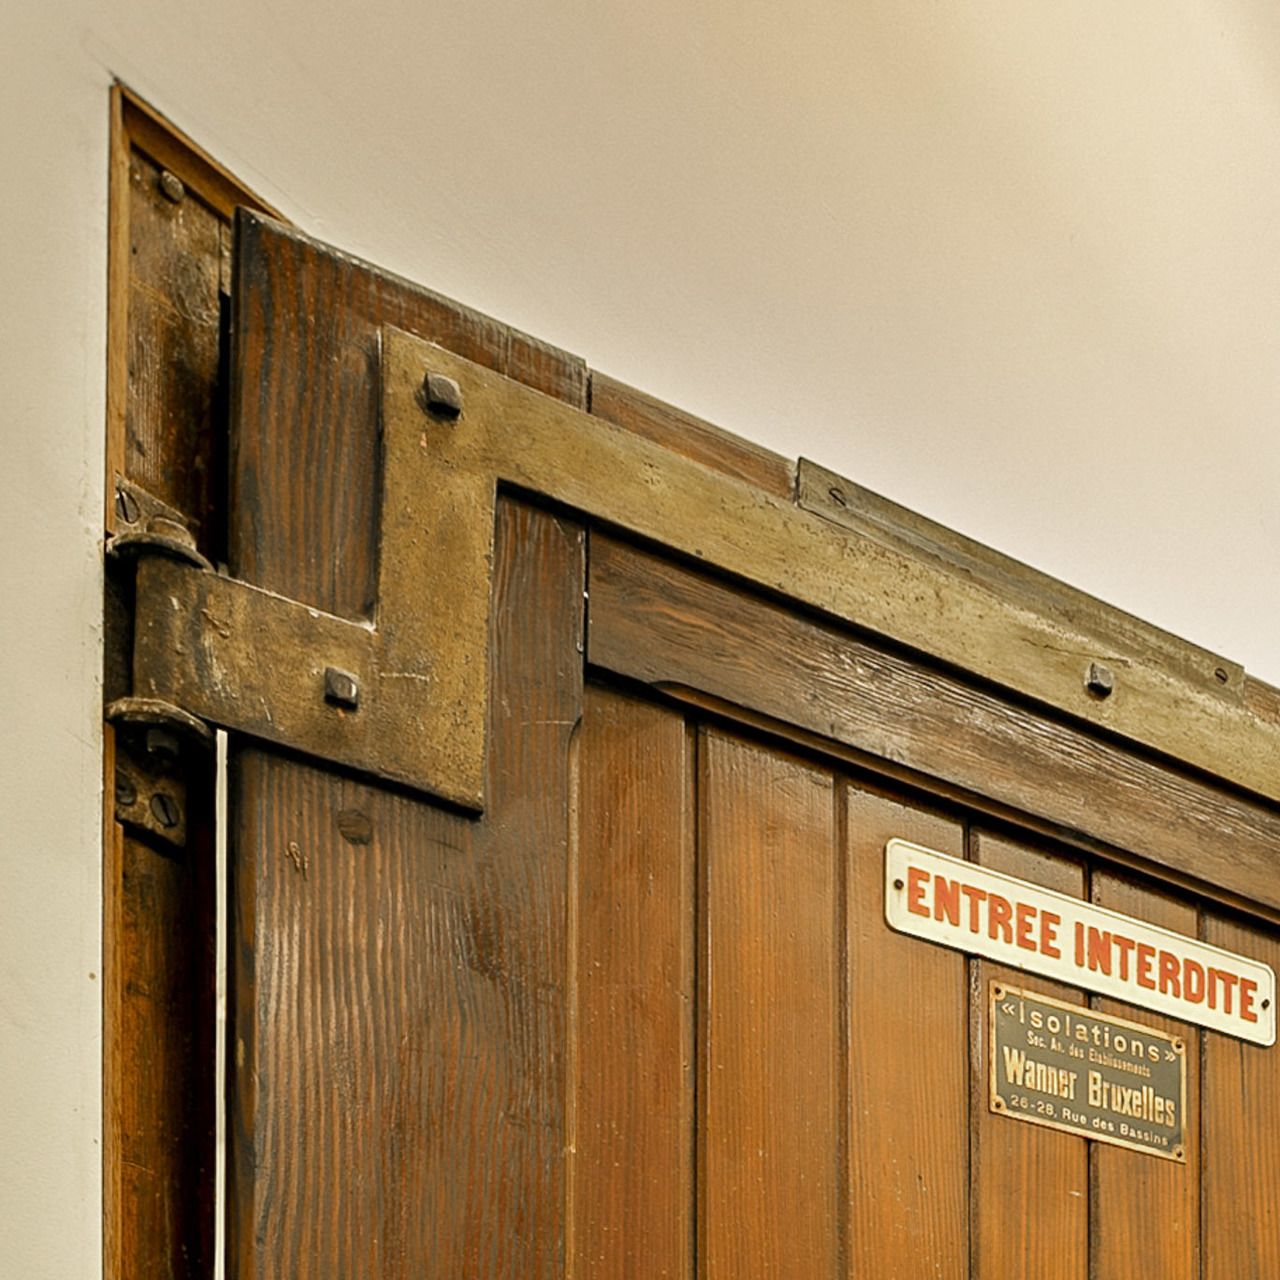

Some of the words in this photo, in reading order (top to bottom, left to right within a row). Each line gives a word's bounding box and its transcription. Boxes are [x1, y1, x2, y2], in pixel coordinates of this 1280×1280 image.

[907, 866, 1061, 959] ENTREE
[1075, 921, 1258, 1023] INTERDITE
[1068, 1043, 1085, 1059] des
[1003, 1045, 1078, 1100] Wanner
[1088, 1069, 1176, 1128] Bruxelles
[1010, 1094, 1058, 1118] 26-28,
[1061, 1107, 1088, 1125] Rue
[1092, 1117, 1115, 1133] des
[1119, 1123, 1169, 1147] Bassins
